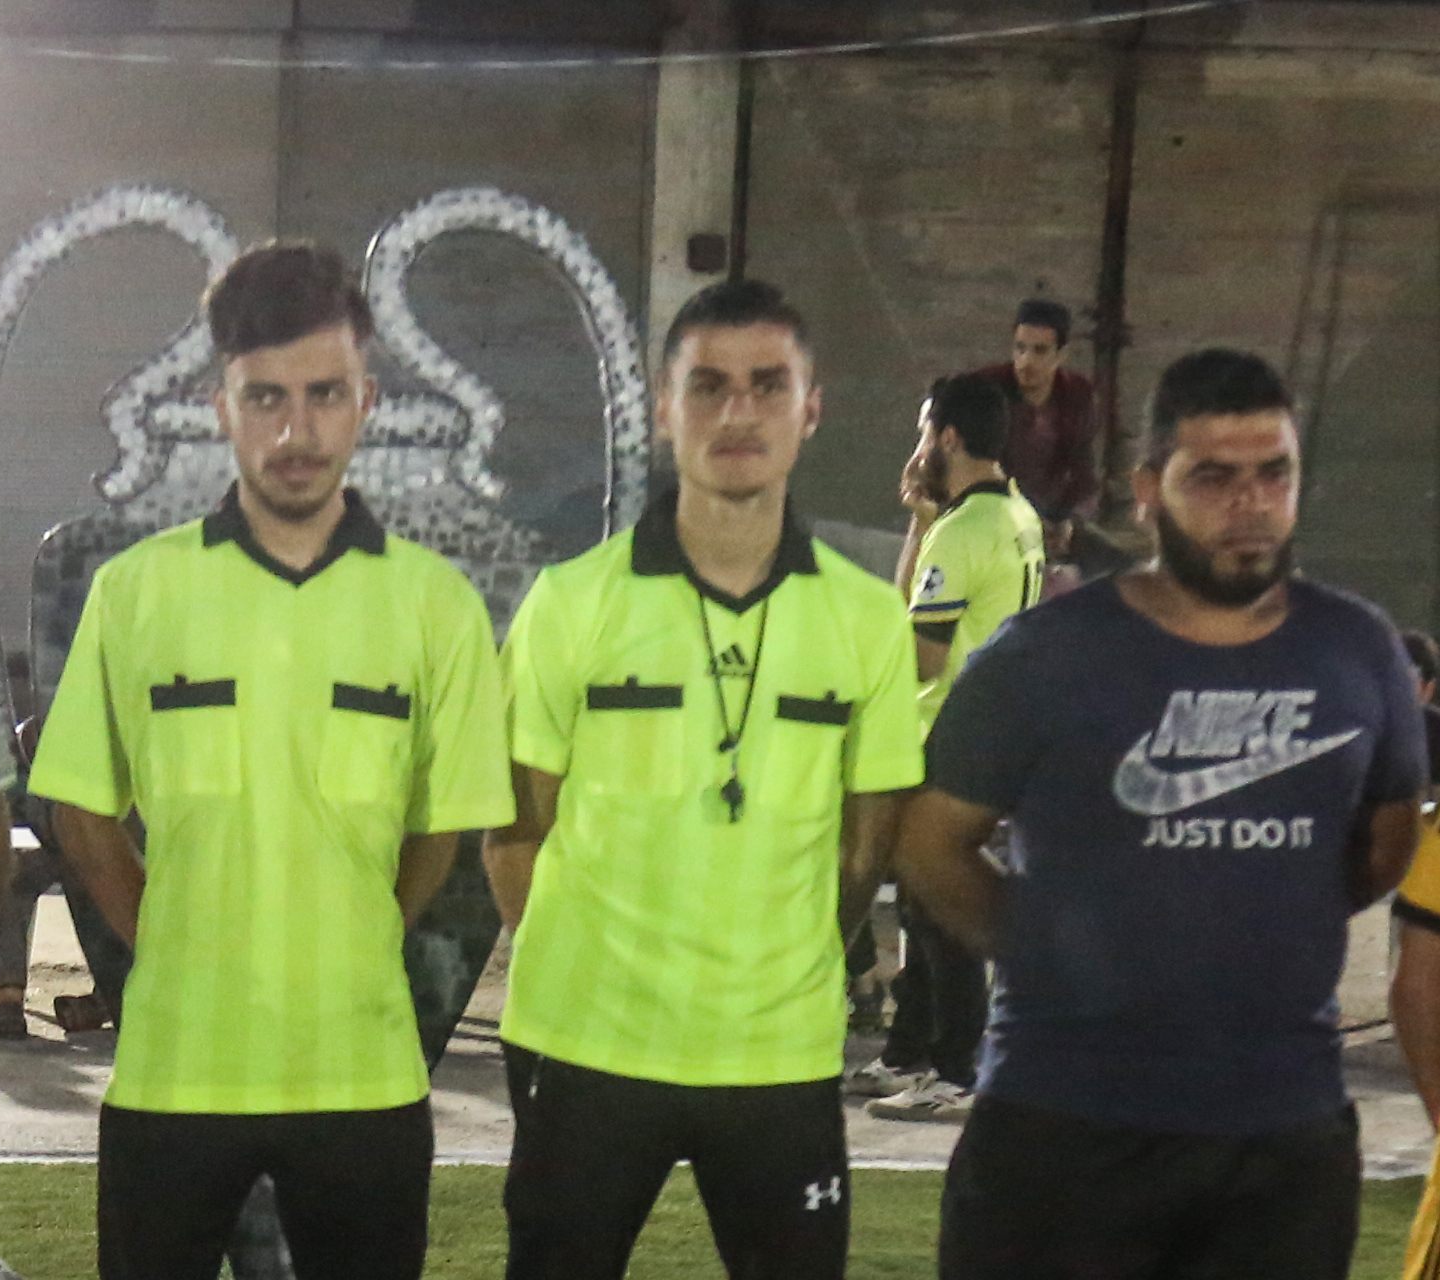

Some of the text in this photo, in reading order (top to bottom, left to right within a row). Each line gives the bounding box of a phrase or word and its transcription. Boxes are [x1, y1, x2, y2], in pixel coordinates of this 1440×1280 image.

[1150, 690, 1317, 757] NIKE
[1142, 817, 1314, 849] JUST DO IT
